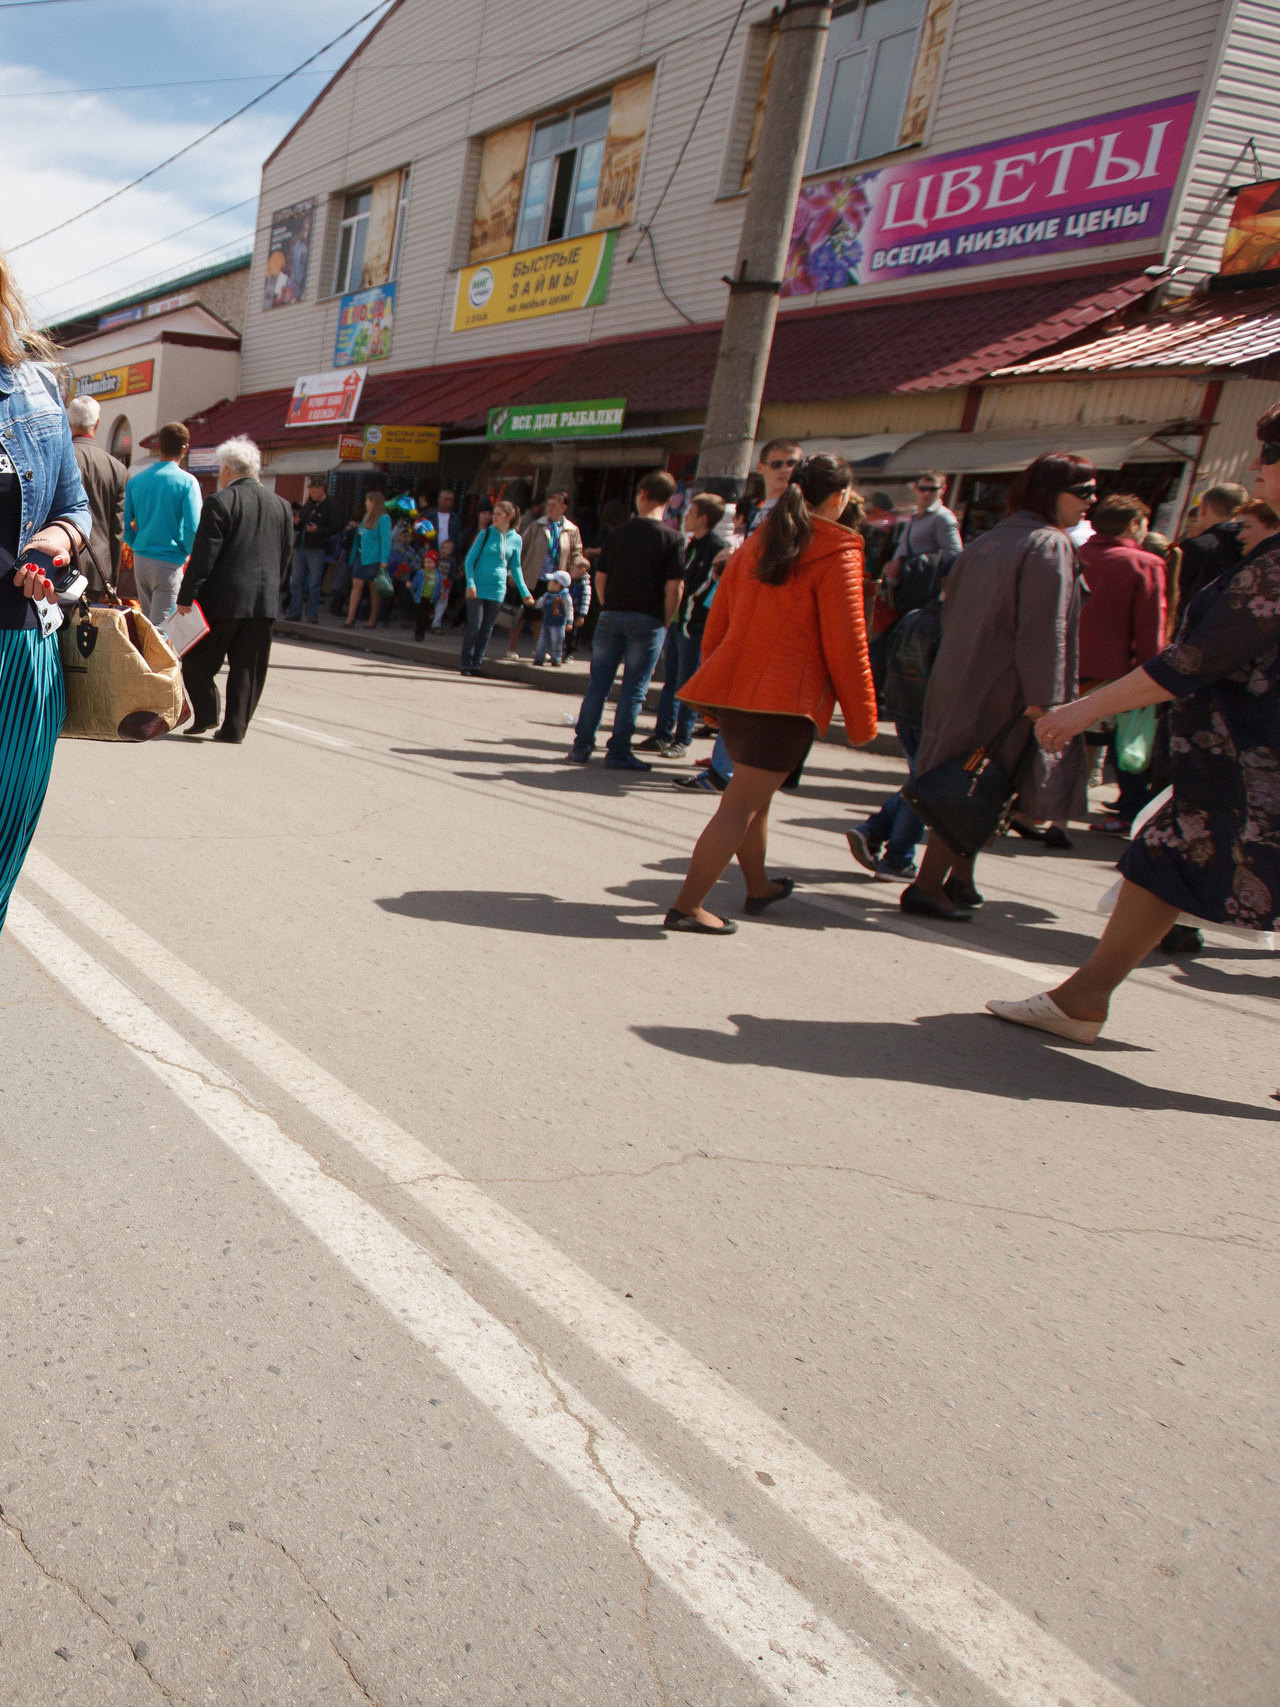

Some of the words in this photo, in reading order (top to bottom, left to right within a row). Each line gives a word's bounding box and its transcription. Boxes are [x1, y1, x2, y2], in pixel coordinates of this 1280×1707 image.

[880, 119, 1174, 233] ЦВЕТЫ
[871, 237, 951, 271] ВСЕГДА
[954, 216, 1062, 257] НИЗКИЕ
[1064, 200, 1151, 238] ЦЕНЫ
[512, 246, 582, 278] БЫСТРЫЕ
[511, 414, 533, 431] ВСЕ
[533, 413, 558, 431] ДЛЯ
[560, 408, 624, 428] РЫБАЛКИ
